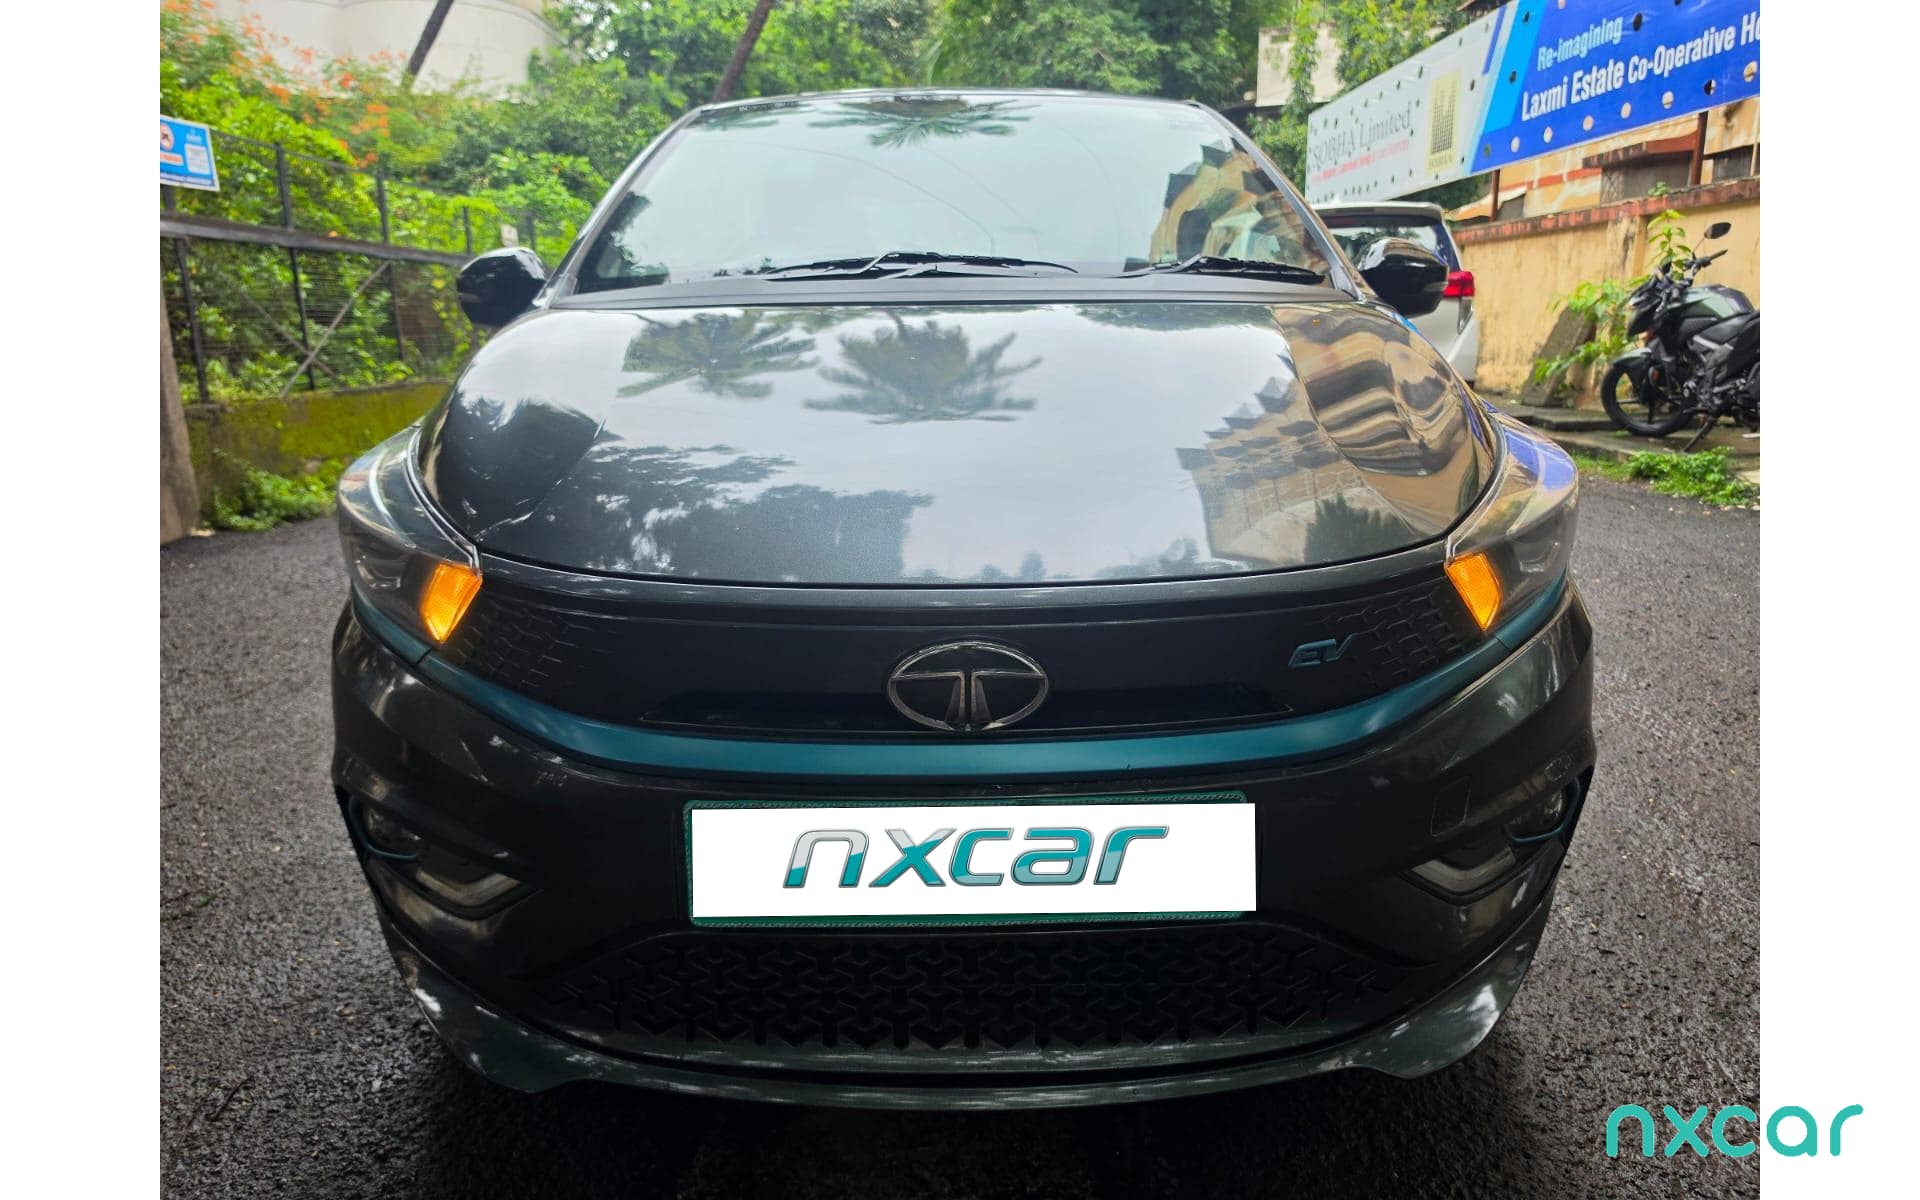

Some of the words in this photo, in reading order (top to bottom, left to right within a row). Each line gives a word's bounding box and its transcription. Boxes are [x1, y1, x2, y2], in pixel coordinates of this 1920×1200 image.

[1537, 16, 1623, 71] Re-imagining
[1522, 76, 1569, 122] Laxmi
[1571, 59, 1625, 104] Estate
[1628, 26, 1736, 84] Co-Operative
[1312, 129, 1355, 165] SOBHA
[1360, 100, 1411, 148] Limited
[1288, 632, 1357, 668] EV
